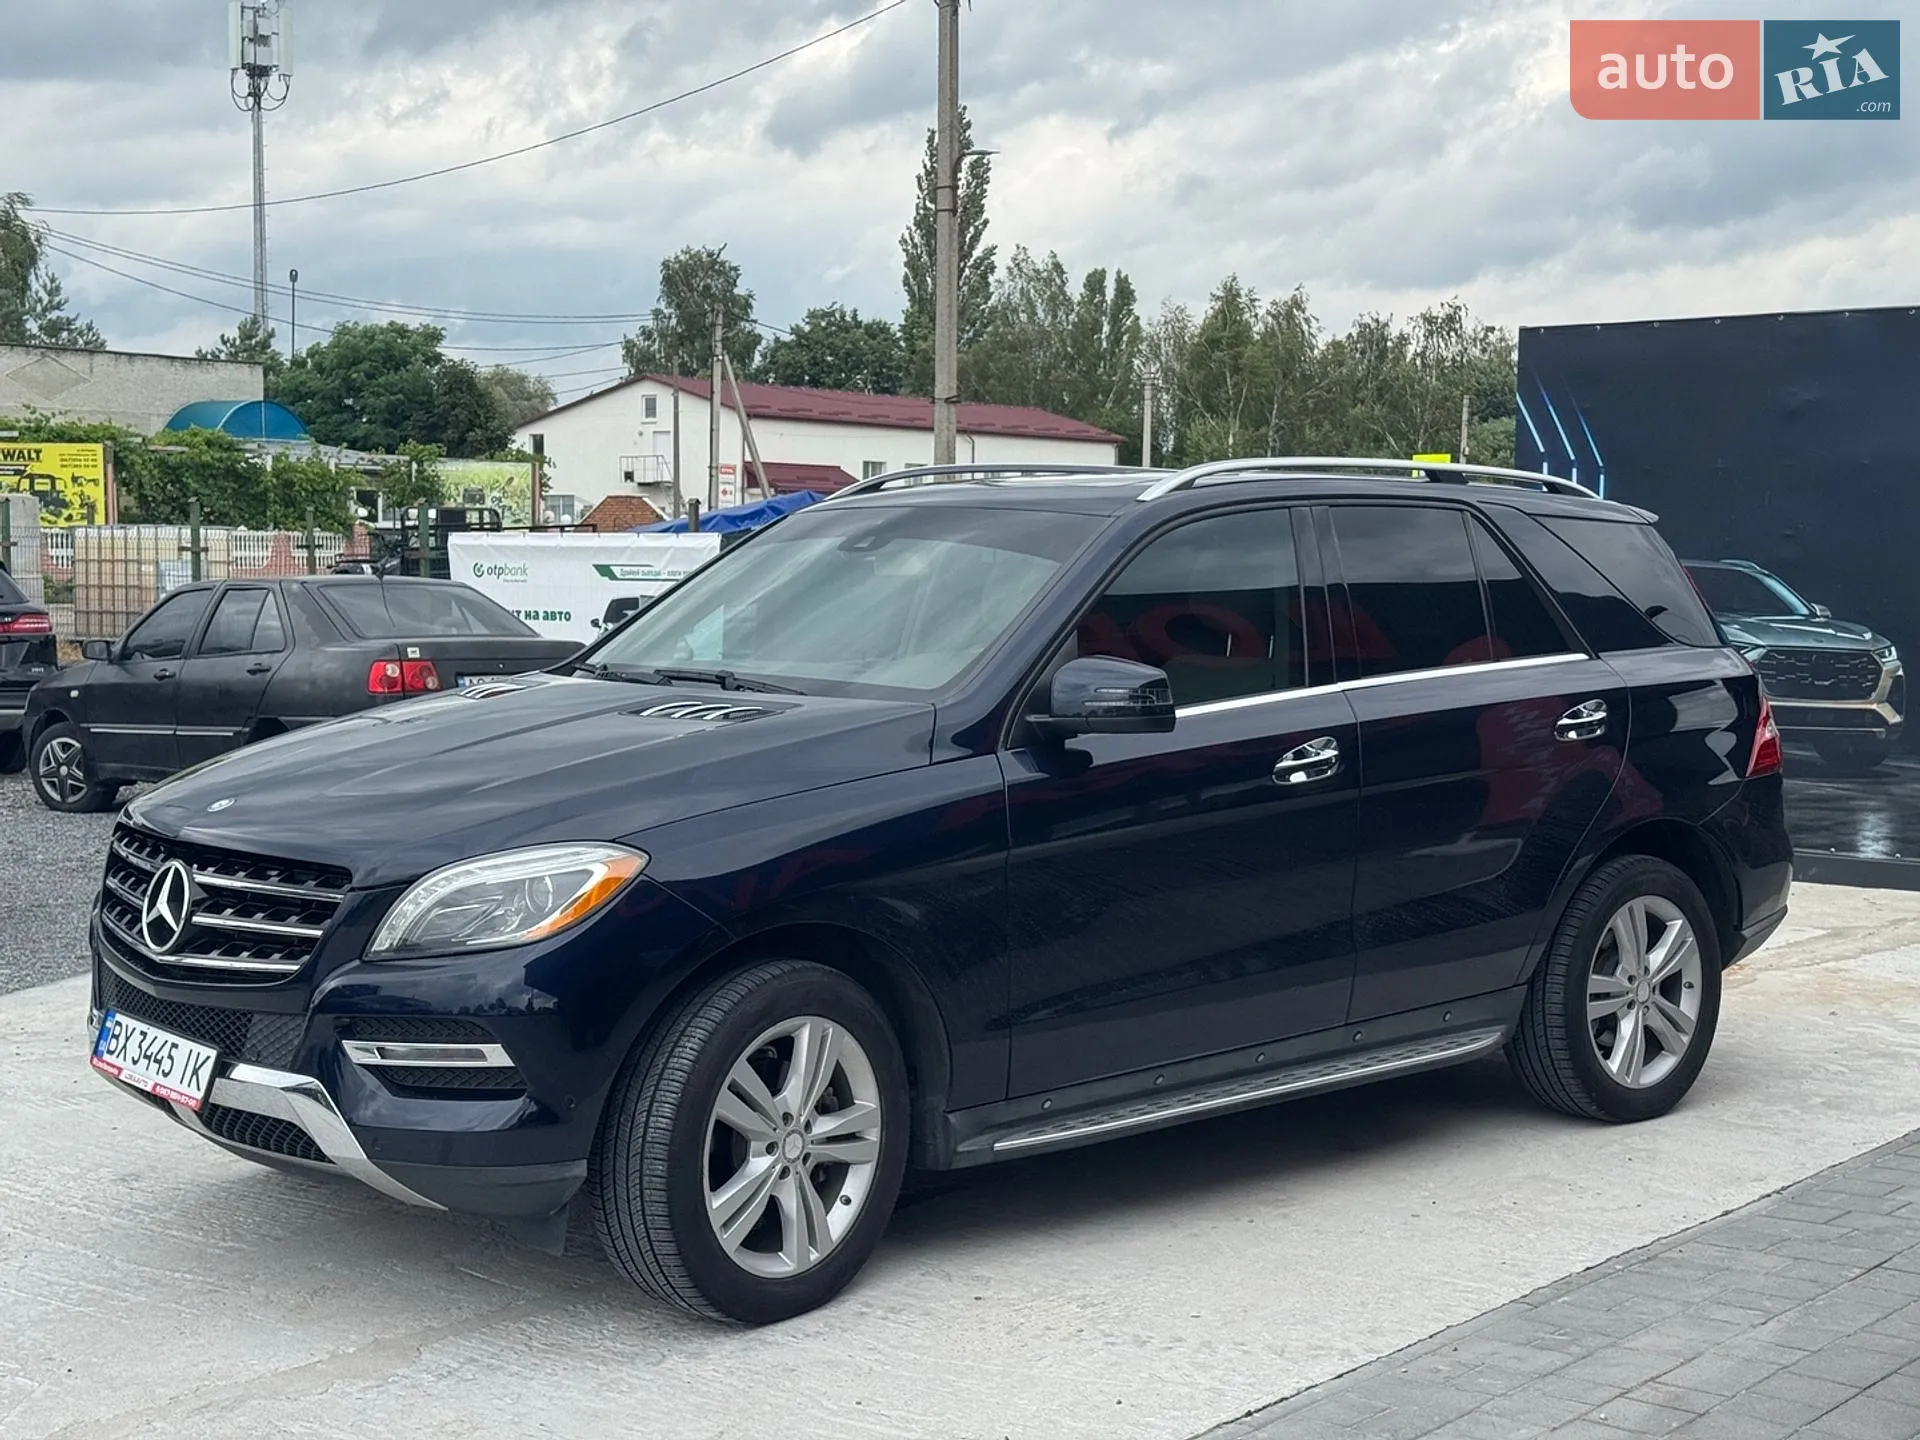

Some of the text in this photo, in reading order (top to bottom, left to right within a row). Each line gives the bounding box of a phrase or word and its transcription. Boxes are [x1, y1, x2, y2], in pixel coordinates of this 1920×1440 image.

[486, 563, 528, 579] otpbank
[525, 610, 539, 620] на
[543, 610, 572, 621] авто
[106, 1020, 136, 1062] BX
[132, 1030, 179, 1078] 3445
[180, 1048, 211, 1091] IK
